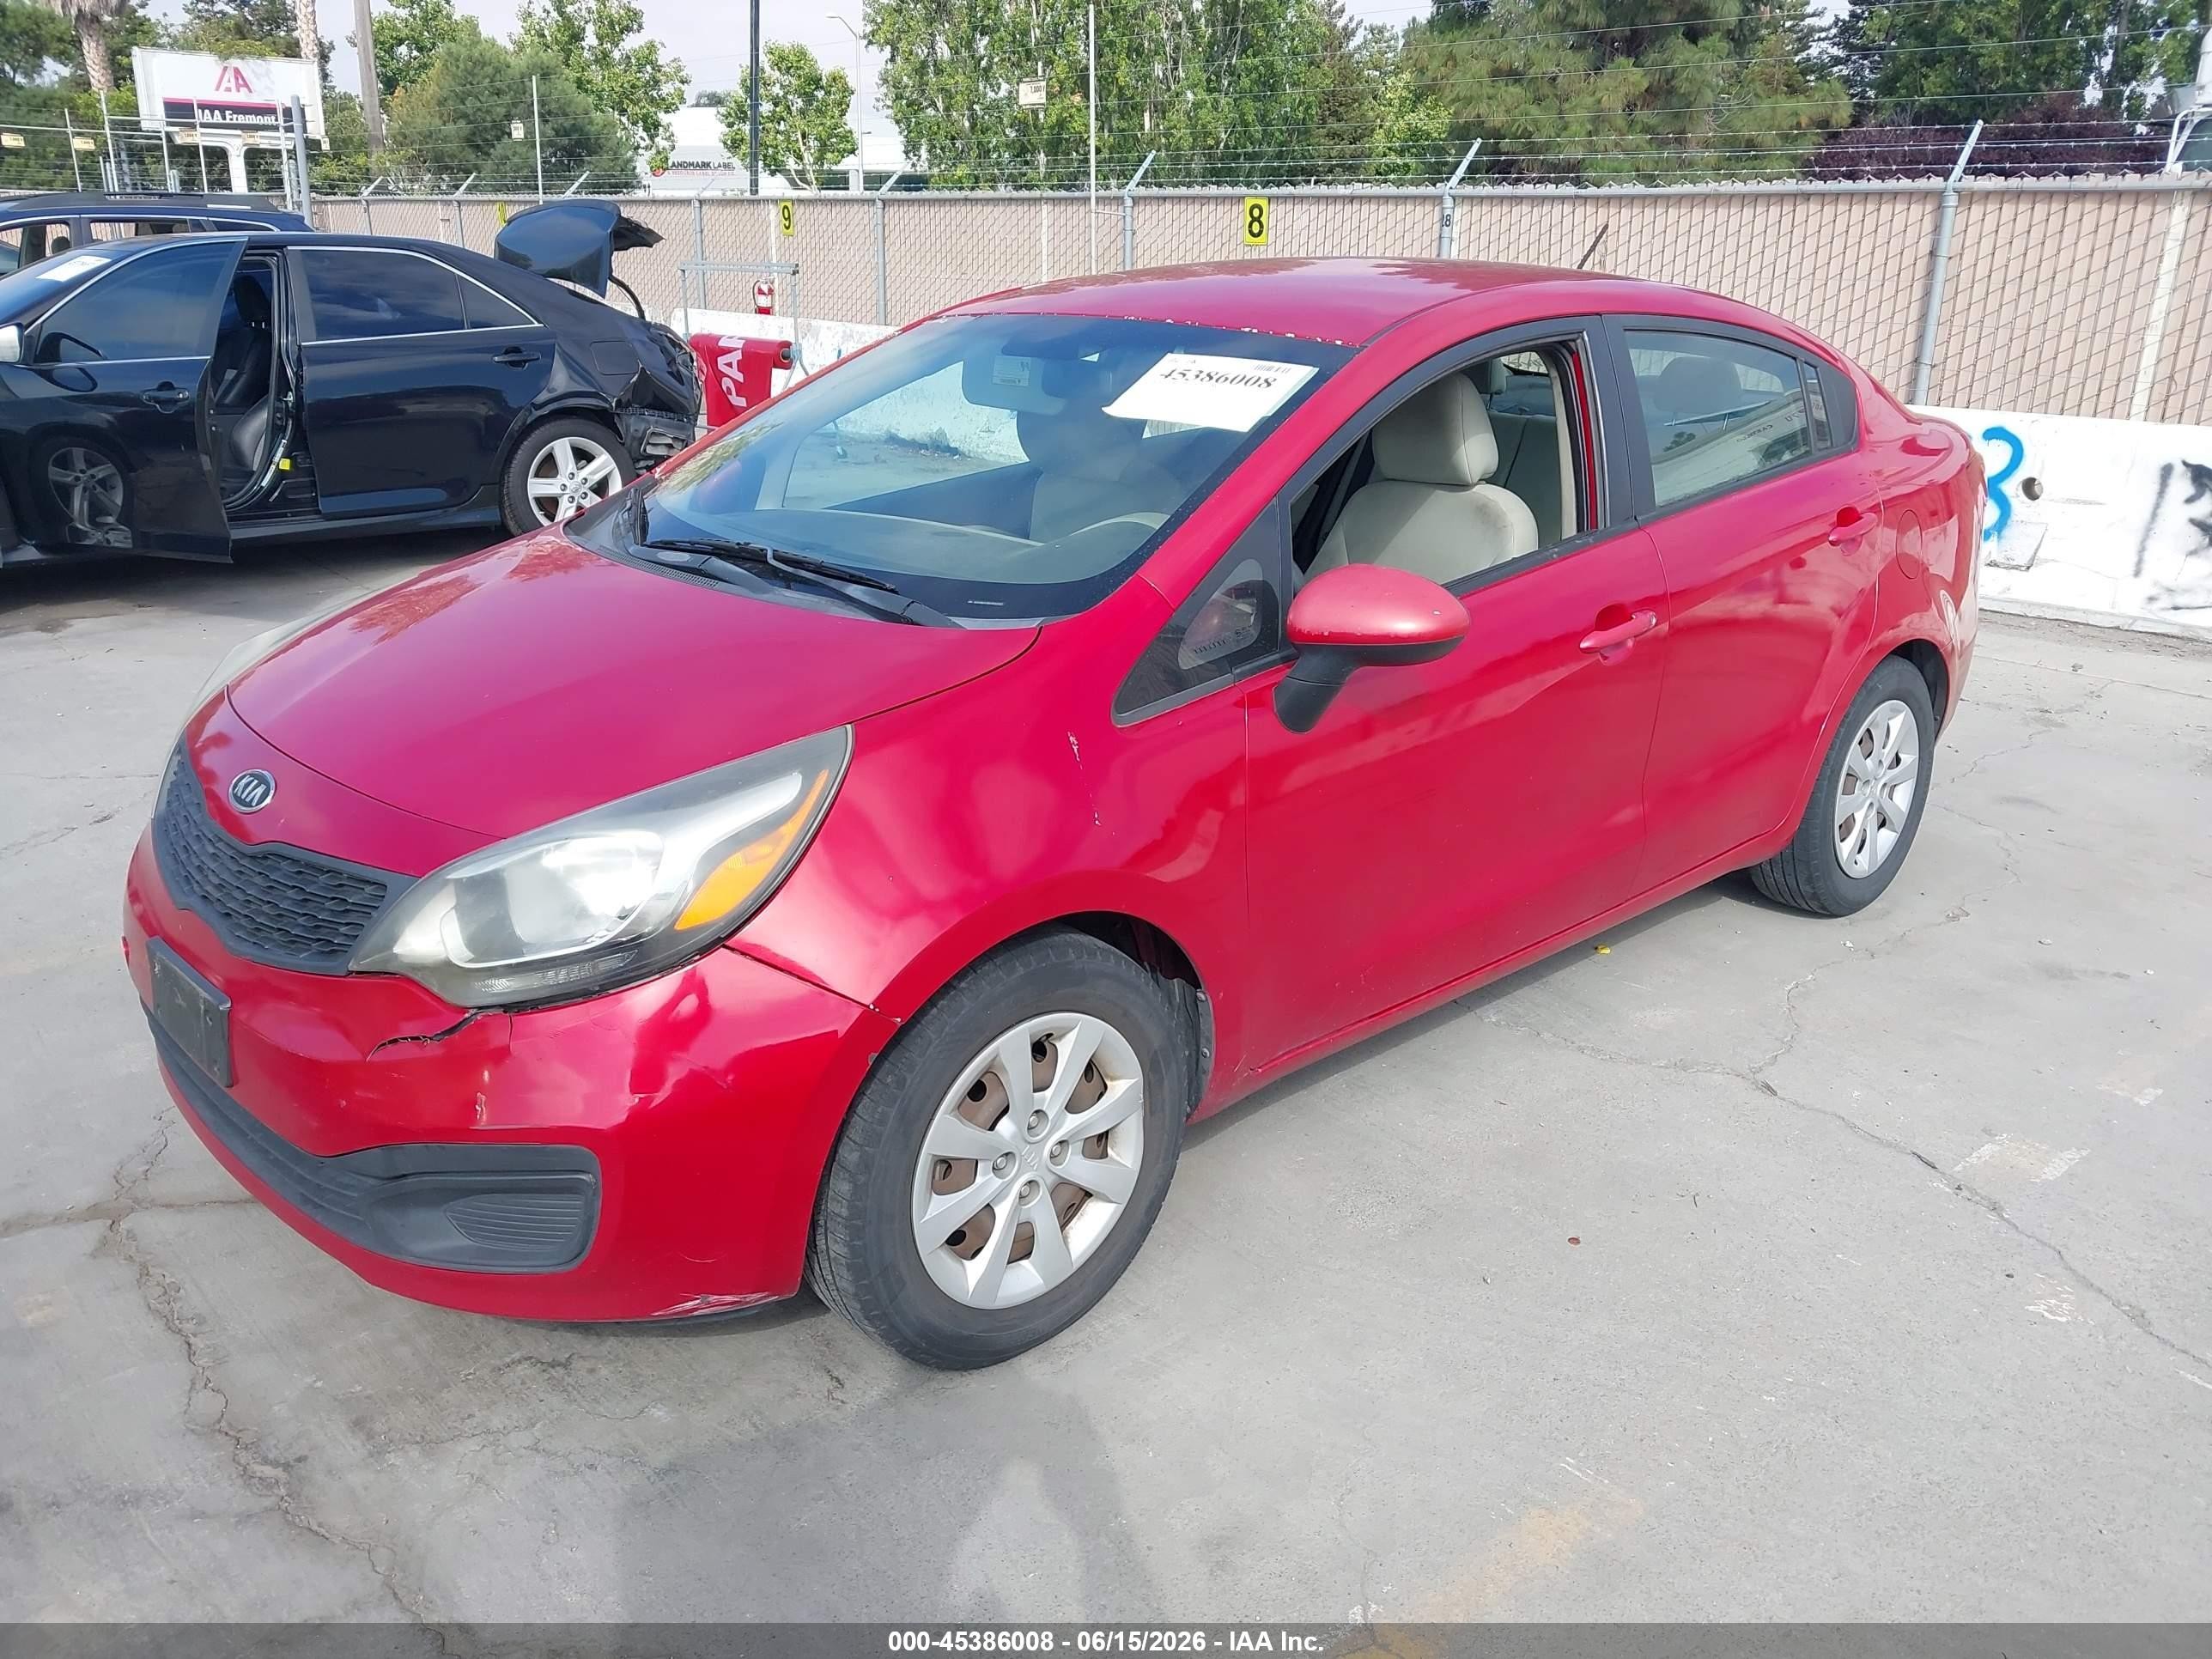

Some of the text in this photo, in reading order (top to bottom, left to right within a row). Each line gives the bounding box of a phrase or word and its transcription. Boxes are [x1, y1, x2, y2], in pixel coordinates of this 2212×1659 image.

[198, 108, 276, 126] IAA Fremont
[670, 161, 736, 170] ANDMARK LABEL
[781, 204, 792, 230] 9
[1248, 203, 1265, 239] 8
[1159, 368, 1278, 389] 45386008
[233, 775, 267, 807] KIA
